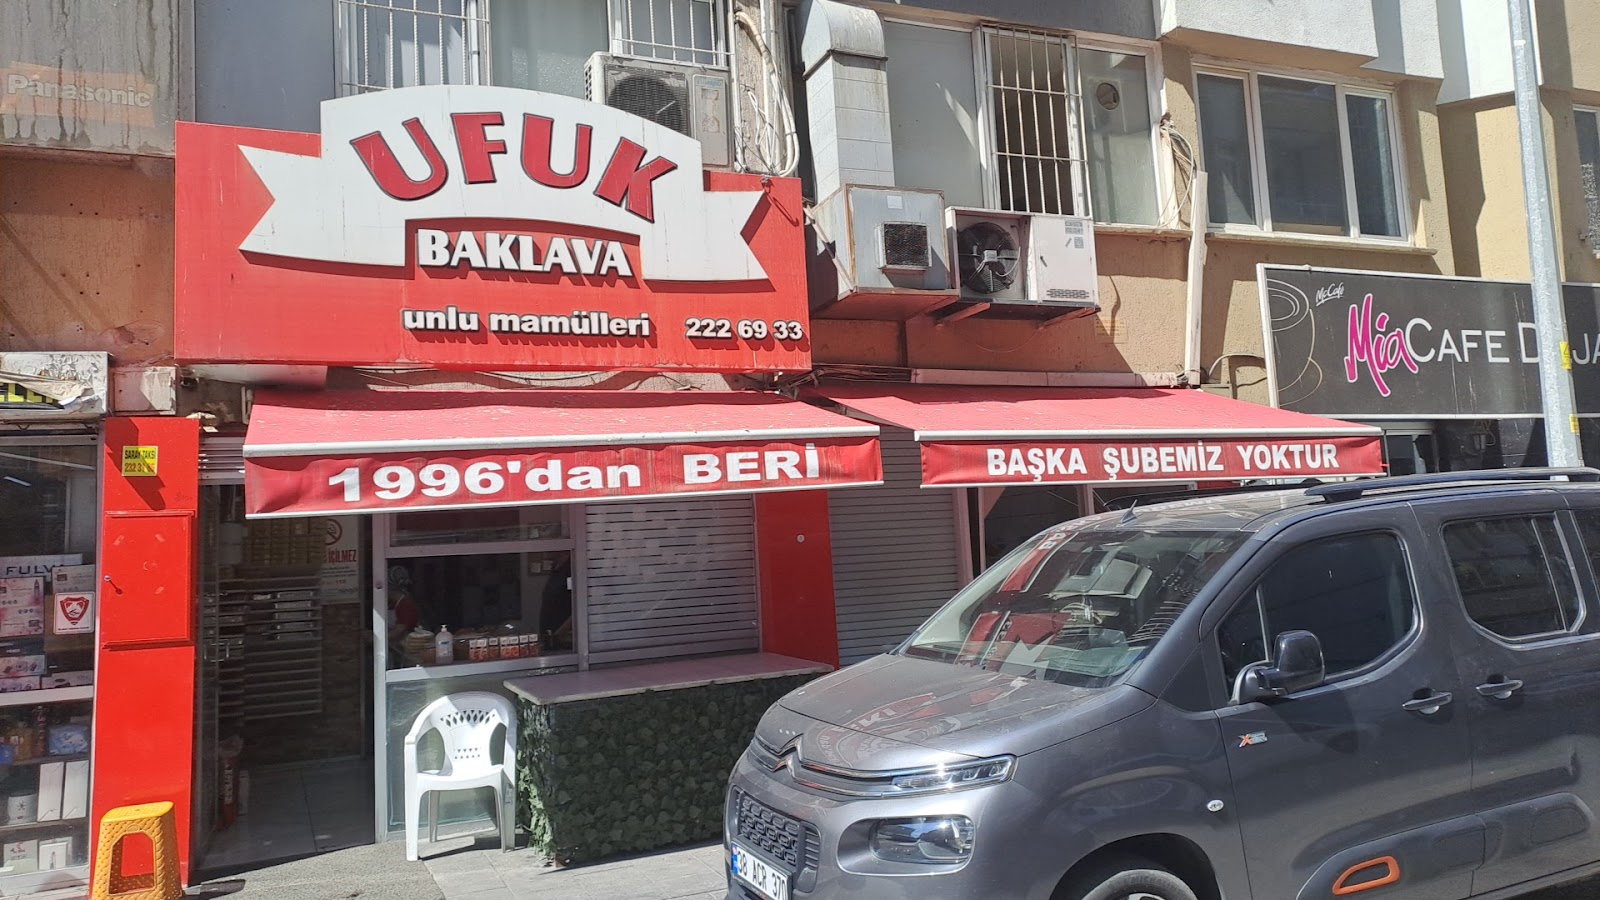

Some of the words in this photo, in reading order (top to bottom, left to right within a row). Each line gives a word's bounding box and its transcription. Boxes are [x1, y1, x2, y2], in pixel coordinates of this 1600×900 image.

[7, 74, 151, 108] Panasonic
[349, 111, 678, 223] UFUK
[416, 228, 633, 277] BAKLAVA
[403, 306, 479, 332] unlu
[489, 310, 651, 337] mamülleri
[685, 317, 732, 338] 222
[738, 319, 769, 340] 69
[773, 320, 803, 340] 33
[1405, 318, 1510, 363] CAFE
[328, 459, 641, 502] 1996'dan
[682, 442, 820, 484] BERİ
[986, 447, 1088, 482] BAŞKA
[1102, 440, 1224, 480] ŞUBEMİZ
[1236, 444, 1340, 470] YOKTUR
[752, 859, 767, 891] ACR
